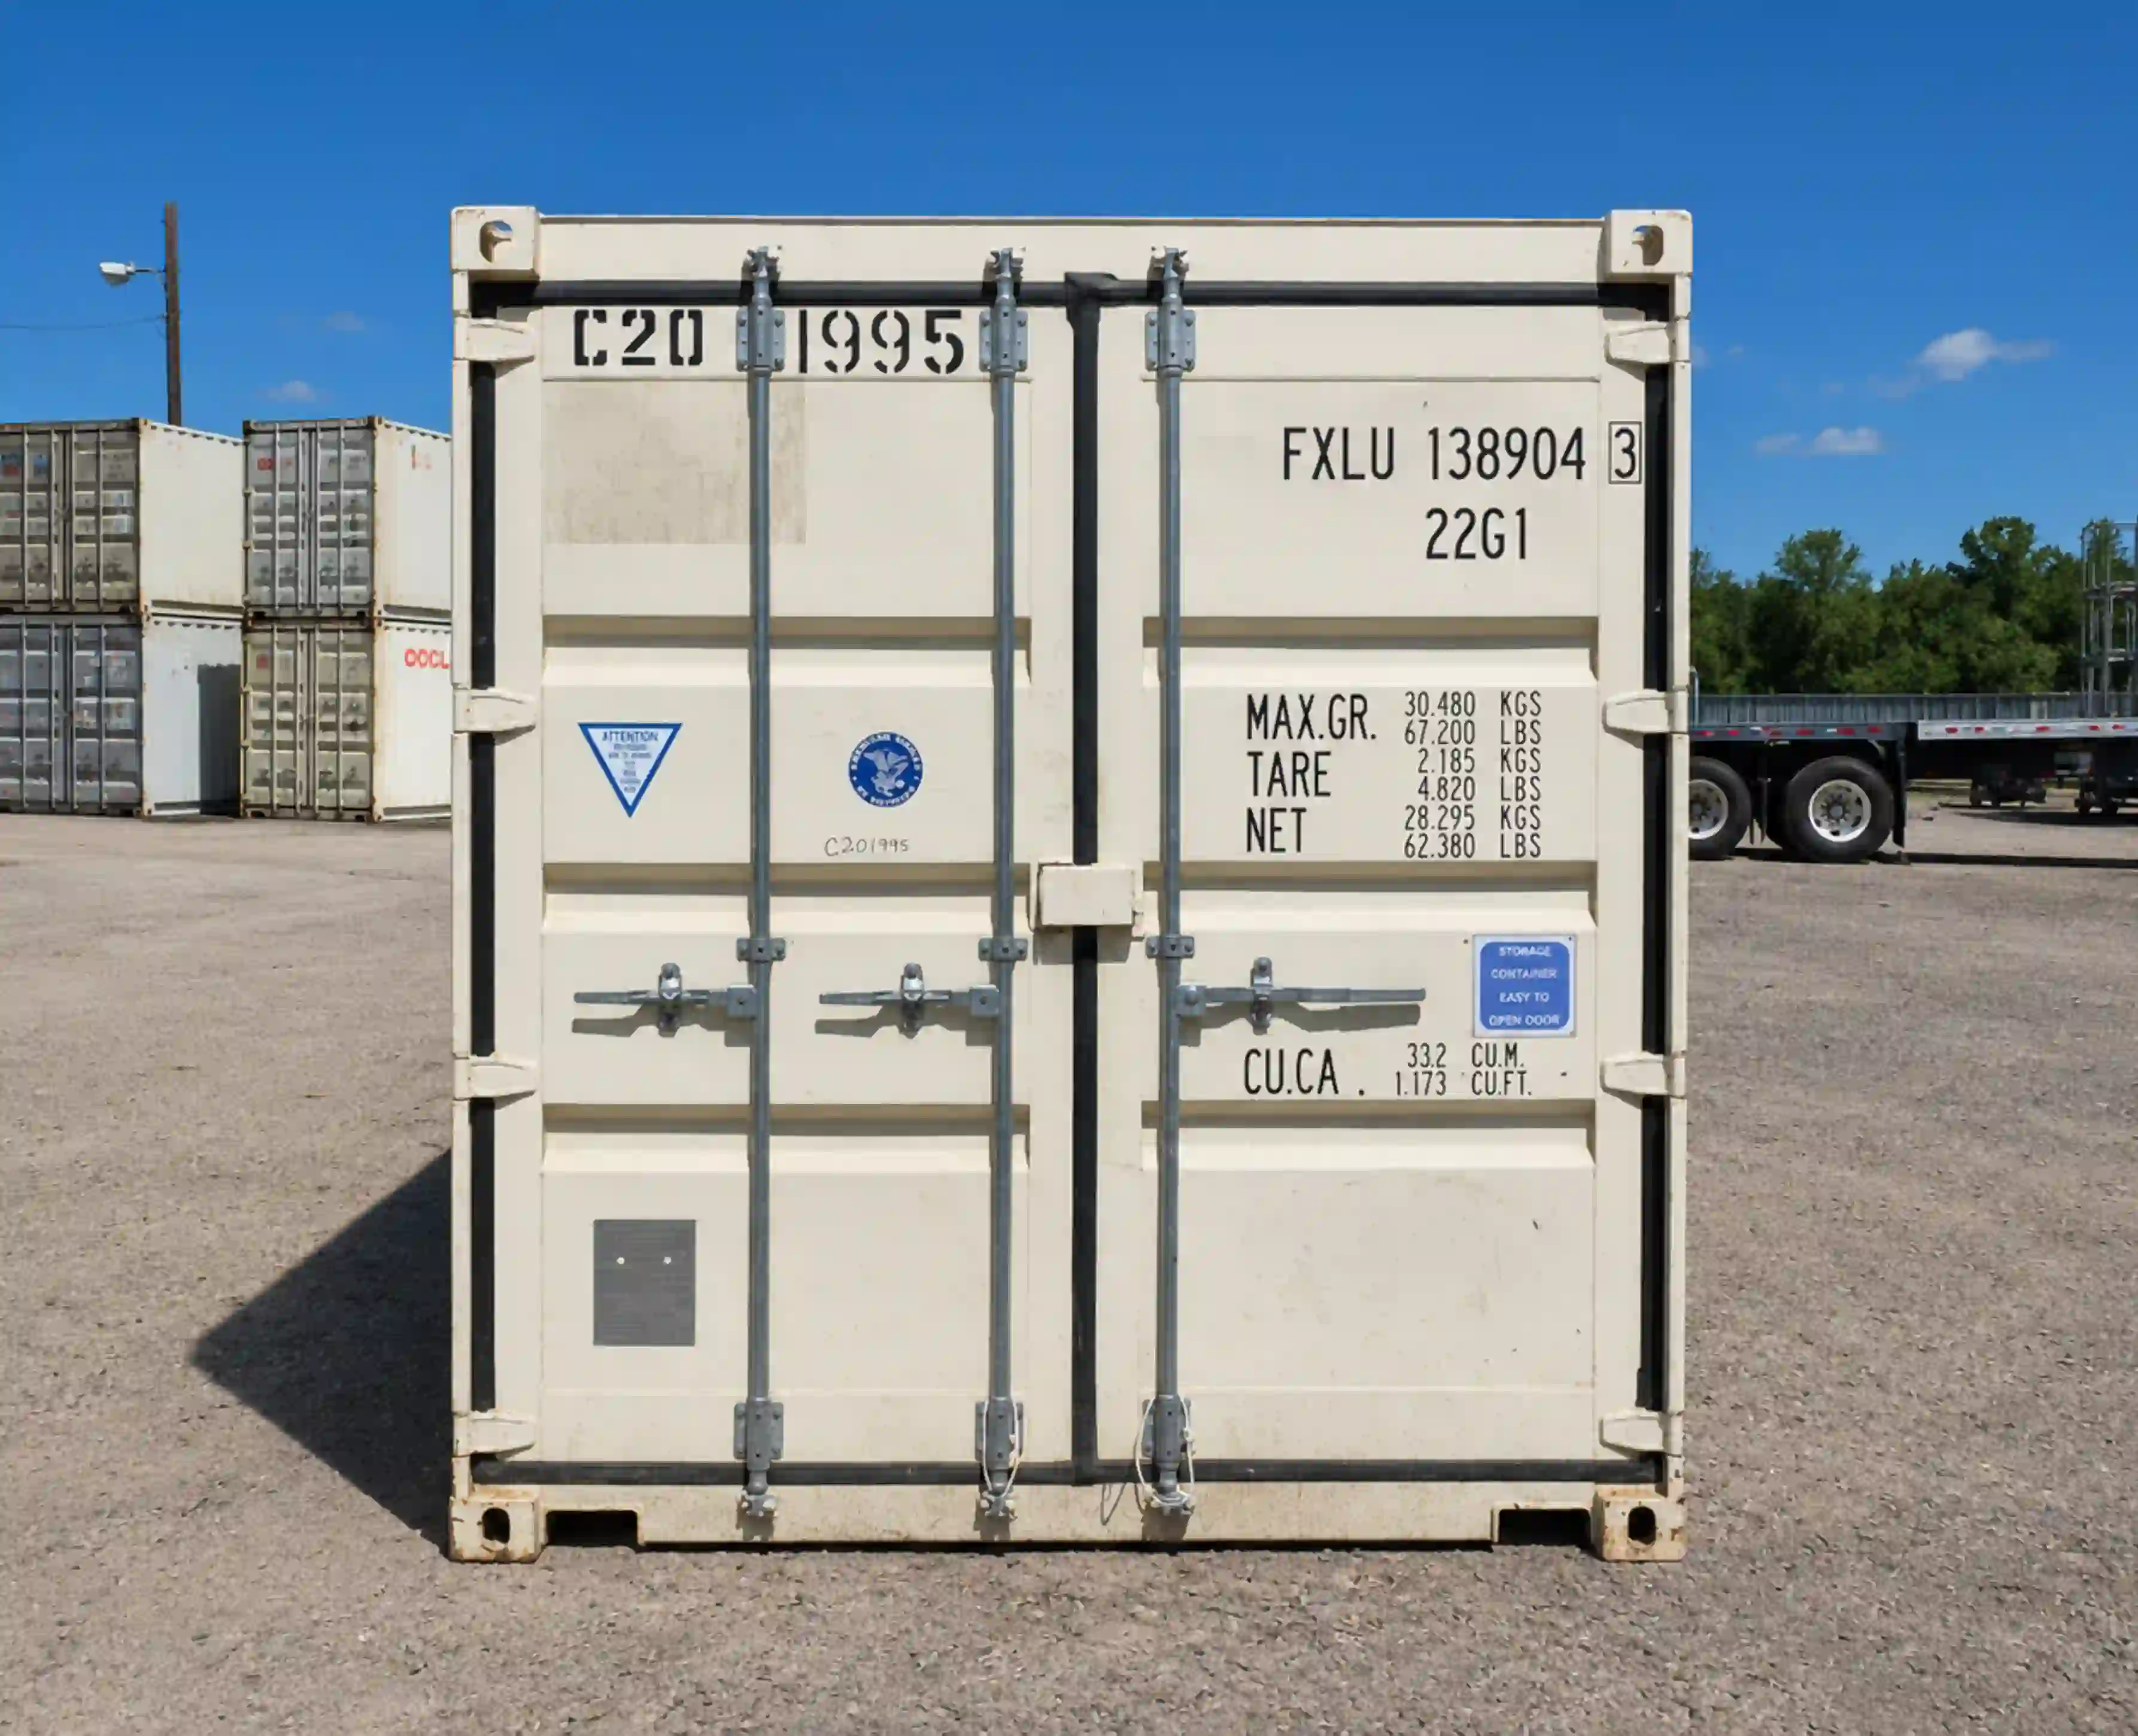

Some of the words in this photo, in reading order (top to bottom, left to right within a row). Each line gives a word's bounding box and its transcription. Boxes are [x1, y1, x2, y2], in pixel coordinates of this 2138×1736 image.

[575, 309, 702, 366] C20
[800, 309, 963, 374] 1995
[1284, 427, 1394, 480] FXLU
[1429, 427, 1586, 480] 138904
[1615, 428, 1636, 479] 3
[1426, 508, 1526, 559] 22G1
[1405, 691, 1475, 717] 30.480
[1501, 690, 1541, 717] KGS
[1247, 694, 1376, 740] MAX.GR.
[1405, 720, 1475, 745] 67.200
[1501, 720, 1541, 745] LBS
[1418, 747, 1475, 774] 2.185
[1501, 747, 1541, 773] KGS
[1247, 751, 1331, 797] TARE
[1418, 776, 1475, 802] 4.820
[1501, 776, 1541, 802] LBS
[1247, 807, 1307, 852] NET
[1405, 805, 1474, 830] 28.295
[1501, 805, 1540, 830] KGS
[824, 836, 909, 857] C201995
[1404, 833, 1475, 858] 62.380
[1501, 833, 1541, 858] LBS
[1499, 946, 1553, 957] STORAGE
[1490, 968, 1557, 979] CONTAINER
[1499, 992, 1530, 1003] EASY
[1535, 993, 1550, 1003] TO
[1408, 1043, 1446, 1068] 33.2
[1472, 1042, 1523, 1068] CU.M.
[1396, 1071, 1446, 1095] 1.173
[1472, 1070, 1531, 1095] CU.FT.
